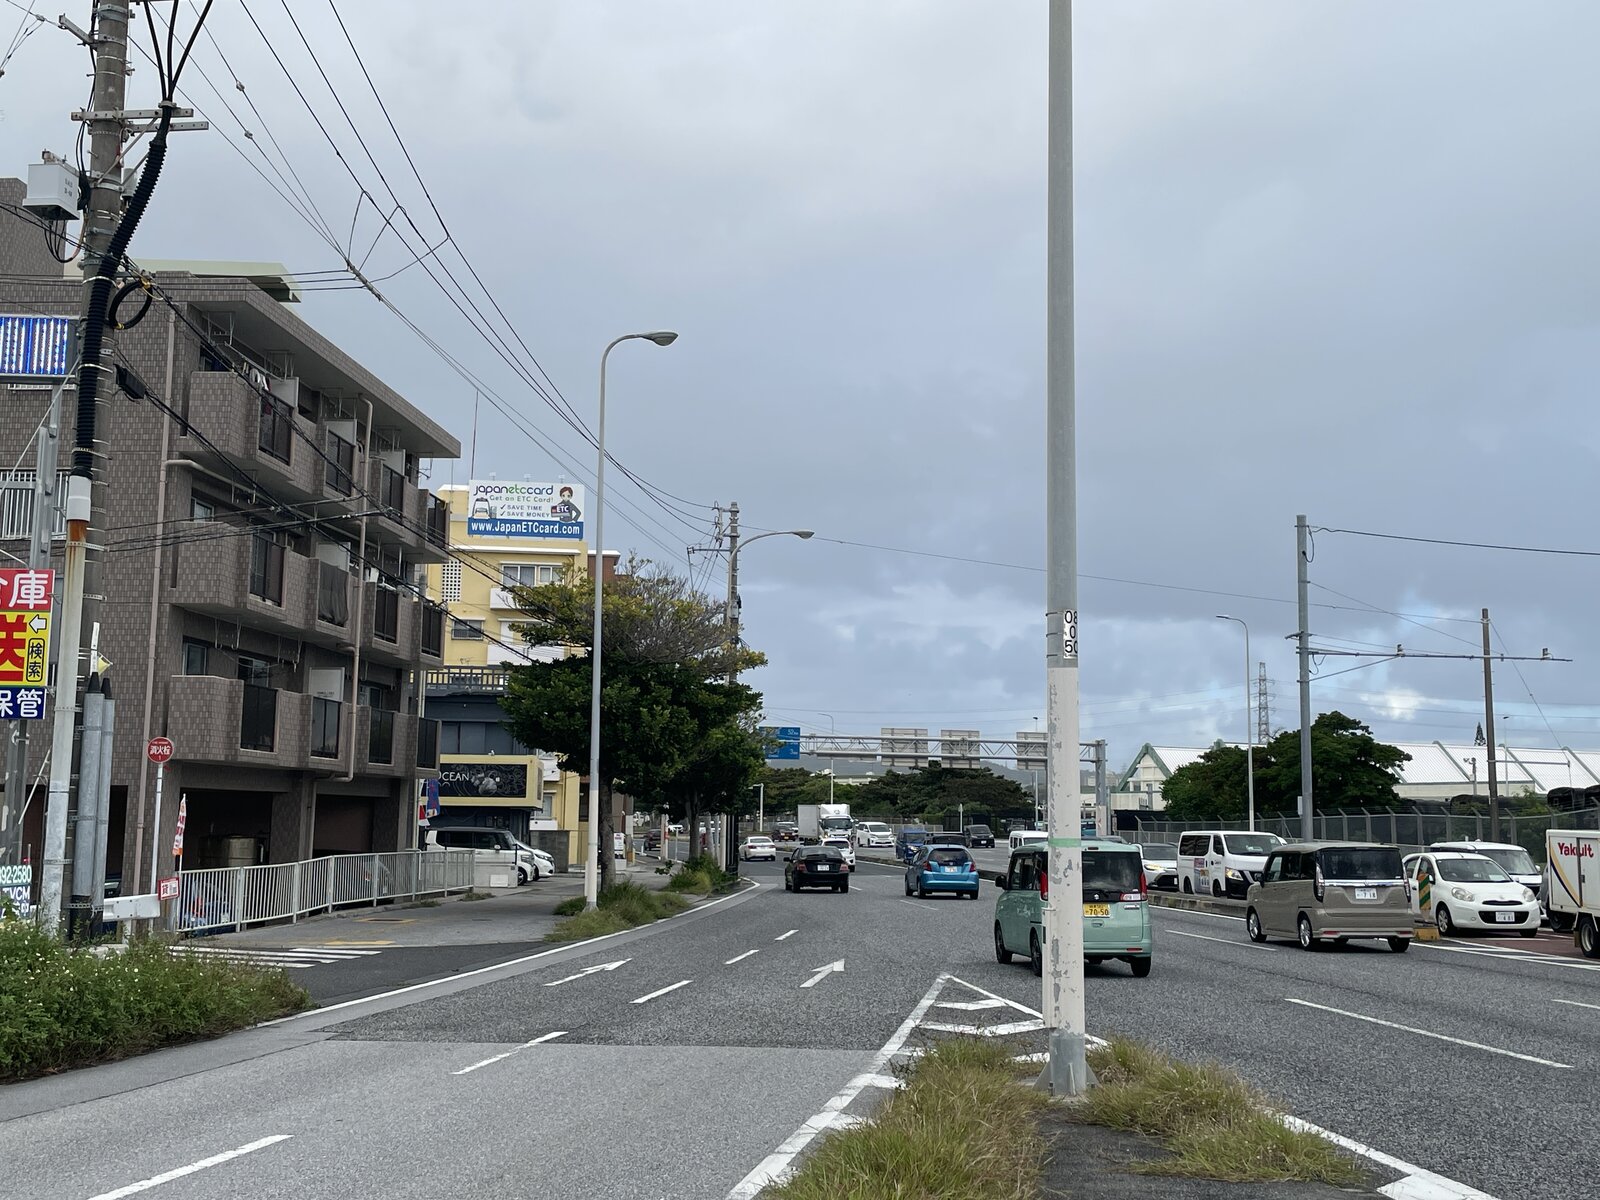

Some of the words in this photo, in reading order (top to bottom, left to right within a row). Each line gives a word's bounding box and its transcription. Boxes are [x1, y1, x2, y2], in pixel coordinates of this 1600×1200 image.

[473, 484, 554, 496] japanetccard
[556, 505, 569, 513] ETC
[471, 521, 580, 535] www.JapanETCcard.com
[28, 643, 43, 679] 検索
[1557, 842, 1594, 858] Yakult
[0, 864, 32, 884] 92-2580
